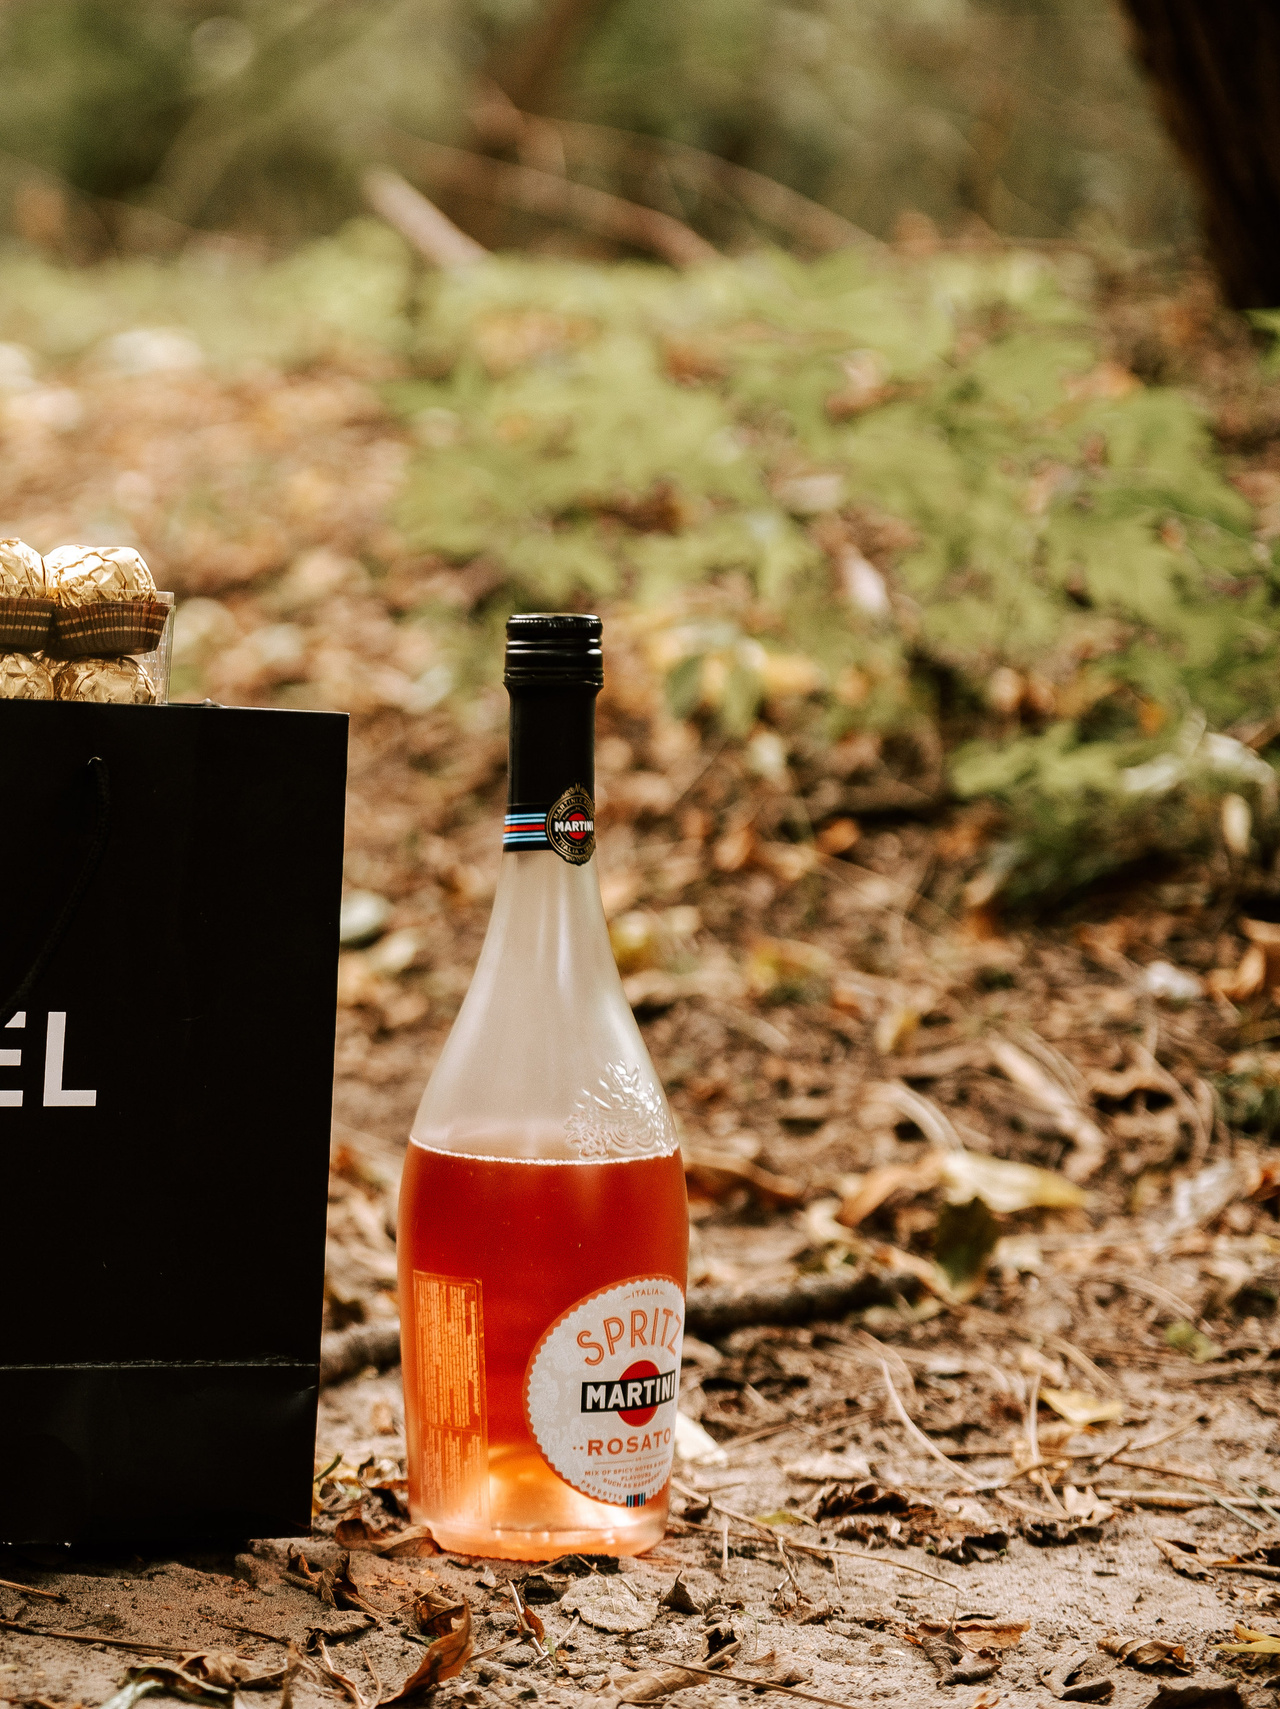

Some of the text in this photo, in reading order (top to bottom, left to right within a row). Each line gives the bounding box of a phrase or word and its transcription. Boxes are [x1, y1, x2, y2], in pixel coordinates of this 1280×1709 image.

[554, 820, 594, 832] MARTINI
[631, 1288, 659, 1298] ITALIA
[576, 1307, 682, 1366] SPRITZ
[586, 1372, 675, 1410] MARTINI
[587, 1427, 671, 1456] ROSATO
[613, 1467, 633, 1475] SPICY
[581, 1479, 622, 1500] PRODOTTO
